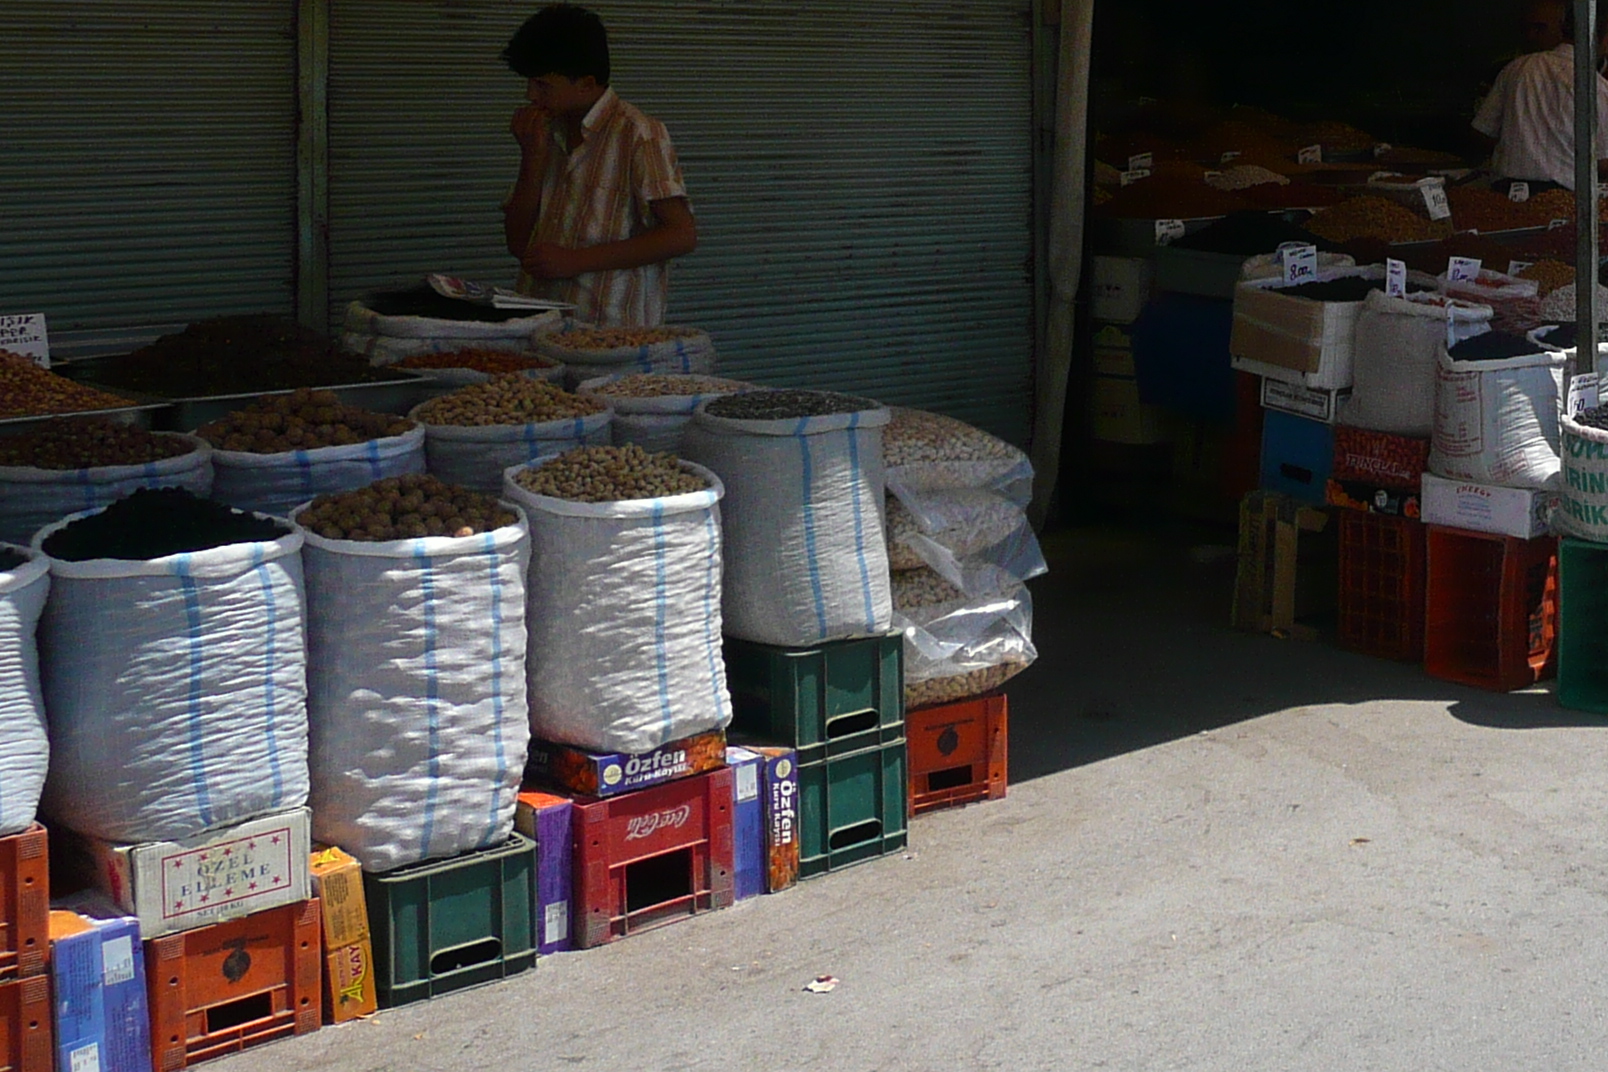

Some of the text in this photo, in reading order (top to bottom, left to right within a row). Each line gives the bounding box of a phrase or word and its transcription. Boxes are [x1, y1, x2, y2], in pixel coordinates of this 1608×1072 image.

[624, 749, 686, 776] Özfen
[624, 771, 651, 786] Kuru
[780, 780, 797, 845] Özfen
